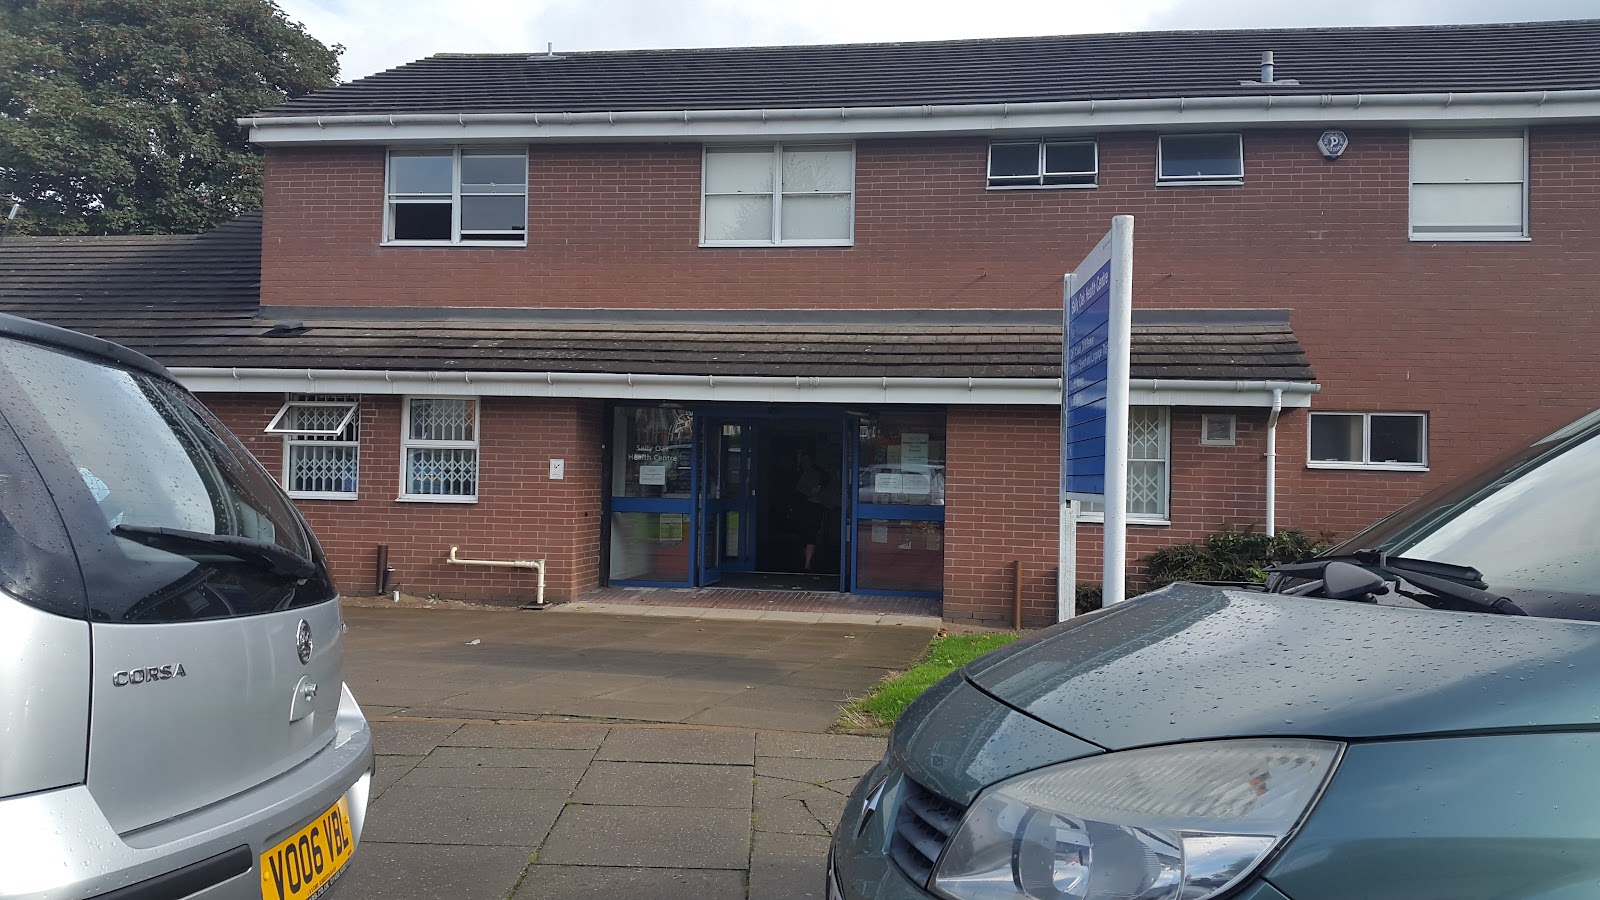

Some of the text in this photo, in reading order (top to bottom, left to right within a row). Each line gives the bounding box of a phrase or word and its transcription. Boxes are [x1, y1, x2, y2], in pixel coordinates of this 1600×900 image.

[1086, 281, 1096, 301] Health
[1096, 272, 1109, 292] Centre
[636, 444, 653, 453] Selly
[653, 454, 678, 462] Centre
[112, 662, 187, 687] CORSA
[323, 806, 350, 863] VBL
